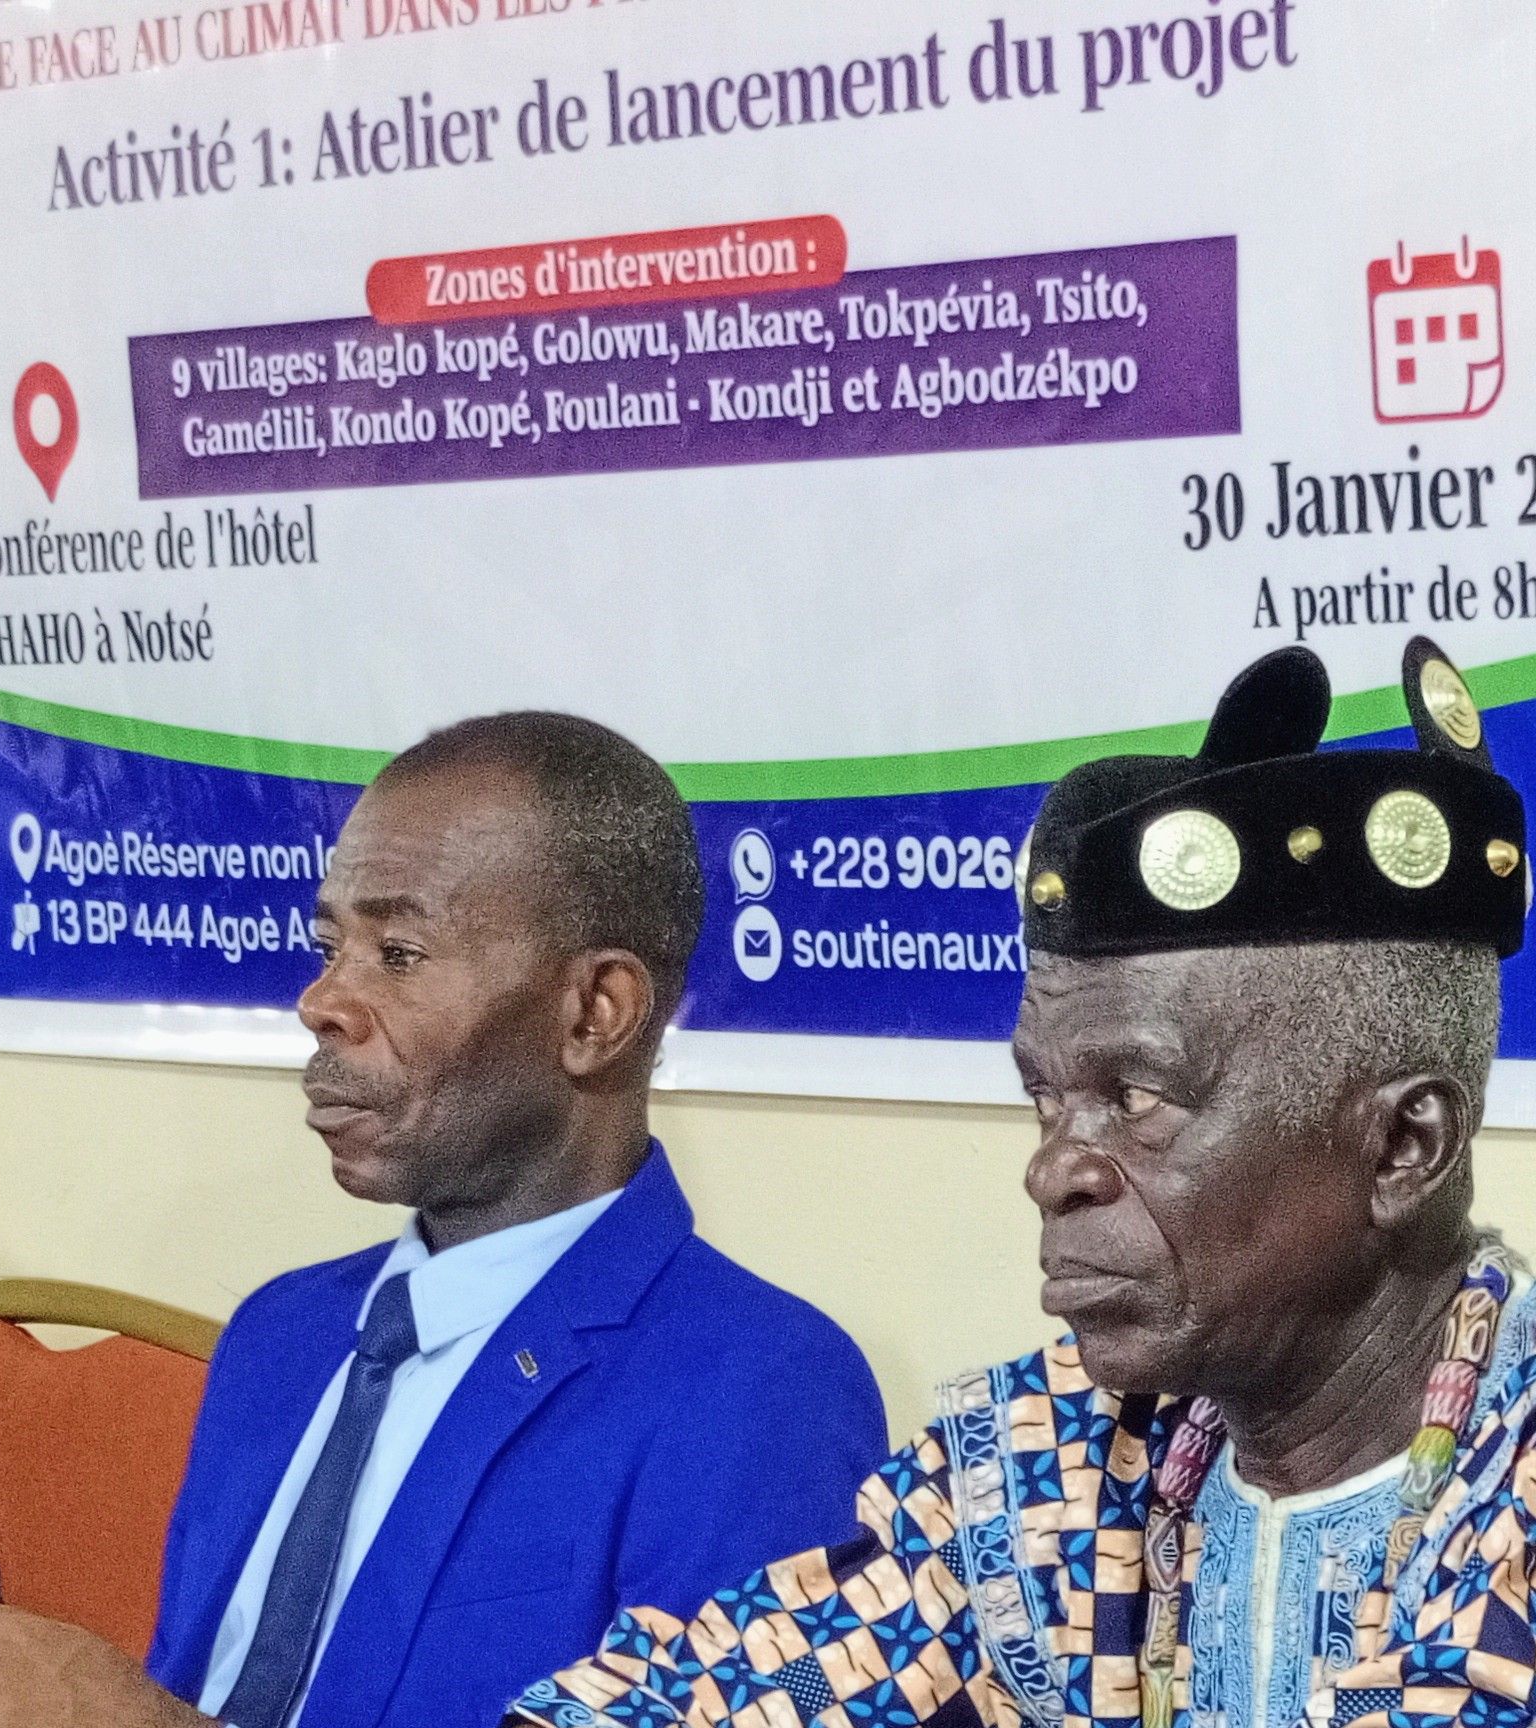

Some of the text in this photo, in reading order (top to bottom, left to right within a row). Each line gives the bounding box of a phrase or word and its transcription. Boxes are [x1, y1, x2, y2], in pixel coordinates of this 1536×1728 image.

[26, 25, 120, 86] FACE
[131, 15, 182, 72] AU
[195, 0, 350, 63] CLIMAT
[47, 0, 1299, 212] Activité 1: Atelier de lancement du projet
[425, 263, 527, 307] Zones
[534, 229, 799, 297] d'intervention
[171, 269, 1148, 398] 9 villages: Kaglo kopé, Golowu, Makare, Tokpévia, Tsito,
[183, 403, 327, 458] Gamélili,
[329, 398, 436, 448] Kondo
[444, 389, 541, 446] Kopé,
[544, 376, 681, 434] Foulani
[708, 365, 834, 427] Kondji
[842, 366, 882, 413] et
[890, 347, 1139, 419] Agbodzékpo
[1181, 472, 1245, 551] 30
[1266, 444, 1495, 540] Janvier
[155, 511, 196, 571] de
[204, 503, 319, 568] l'hôtel
[94, 606, 117, 663] à
[121, 601, 215, 663] Notsé
[1252, 575, 1282, 629] A
[1291, 565, 1415, 641] partir
[1428, 563, 1479, 621] de
[44, 828, 120, 888] Agoè
[122, 830, 246, 880] Réserve
[250, 844, 313, 880] non
[790, 835, 1015, 890] +228 9026
[47, 899, 82, 945] 13
[84, 899, 128, 945] BP
[132, 902, 194, 949] 444
[199, 904, 281, 964] Agoè
